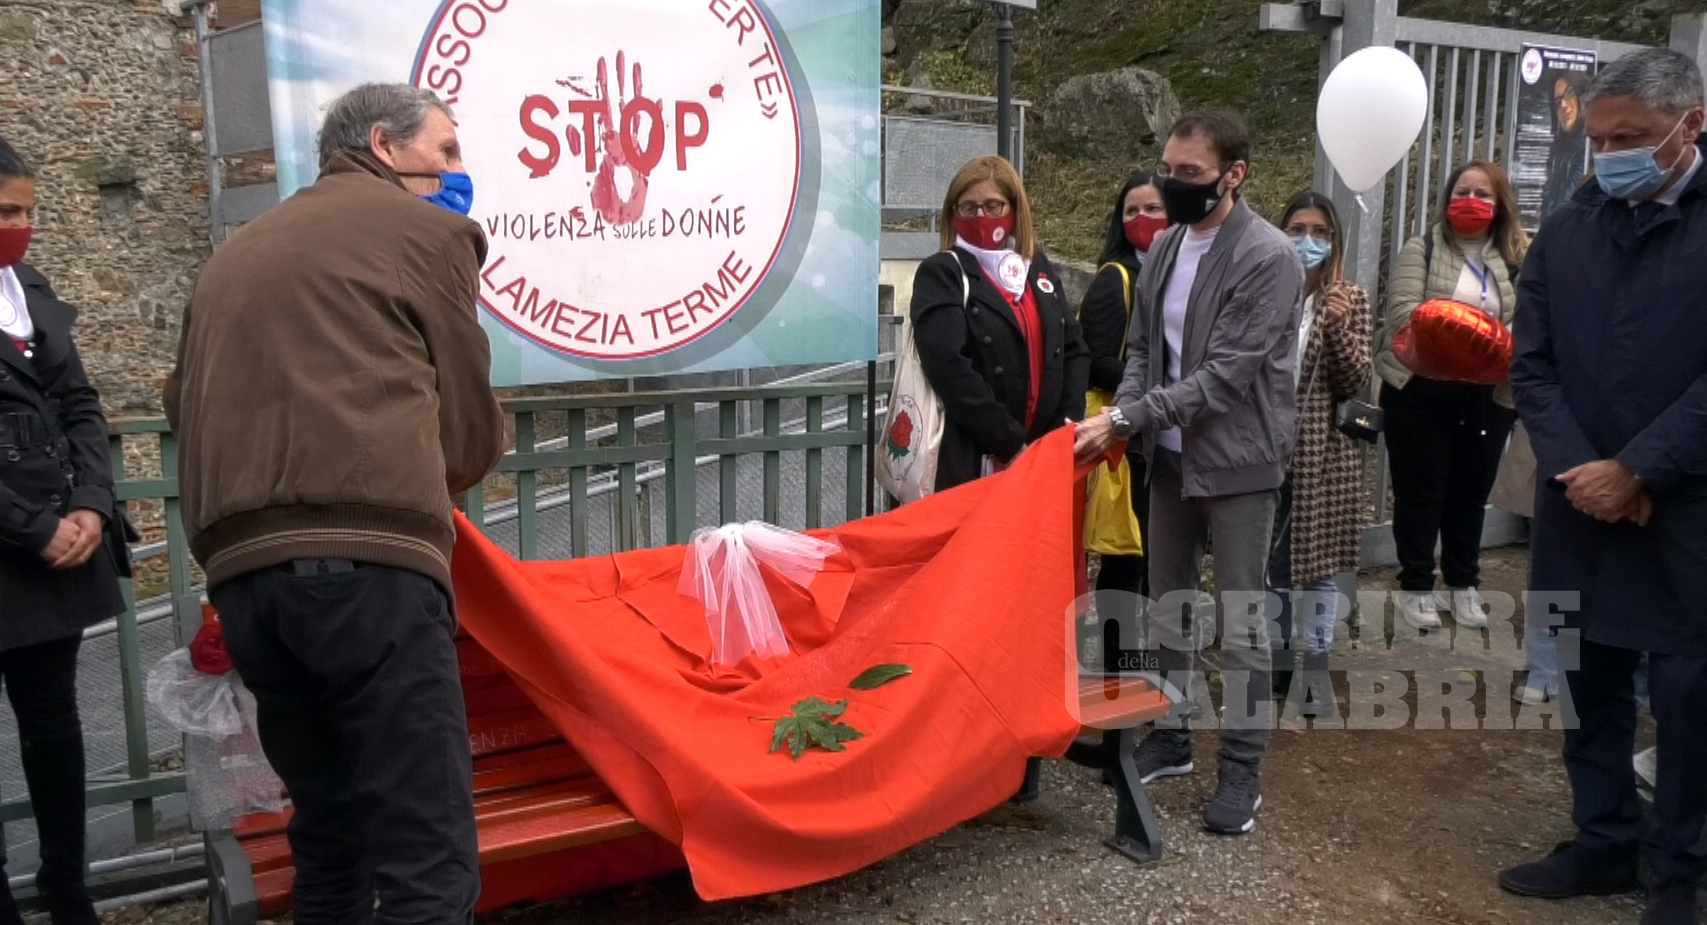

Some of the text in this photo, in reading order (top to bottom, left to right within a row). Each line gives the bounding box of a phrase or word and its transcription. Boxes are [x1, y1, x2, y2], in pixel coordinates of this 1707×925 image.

[708, 0, 756, 46] ER
[517, 94, 710, 178] STOP
[486, 211, 606, 241] VIOLENZA
[661, 205, 746, 240] DONNE
[481, 249, 753, 345] LAMEZIA TERME
[469, 724, 528, 755] ENZA
